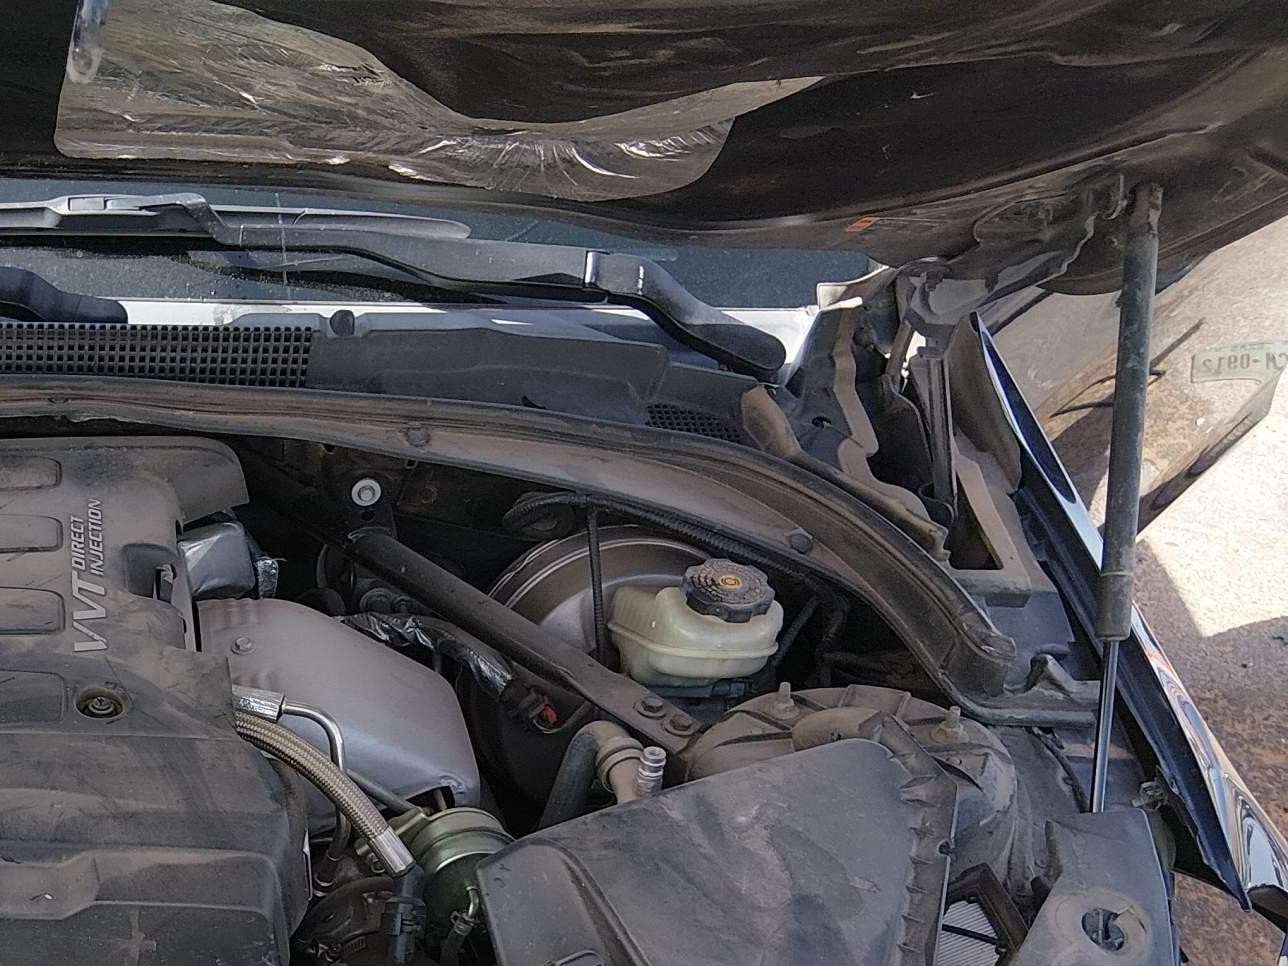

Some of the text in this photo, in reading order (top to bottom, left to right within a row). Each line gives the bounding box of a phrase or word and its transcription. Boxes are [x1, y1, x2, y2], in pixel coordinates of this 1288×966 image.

[70, 515, 86, 571] DIRECT
[88, 498, 104, 576] INJECTION
[72, 570, 108, 651] VVT
